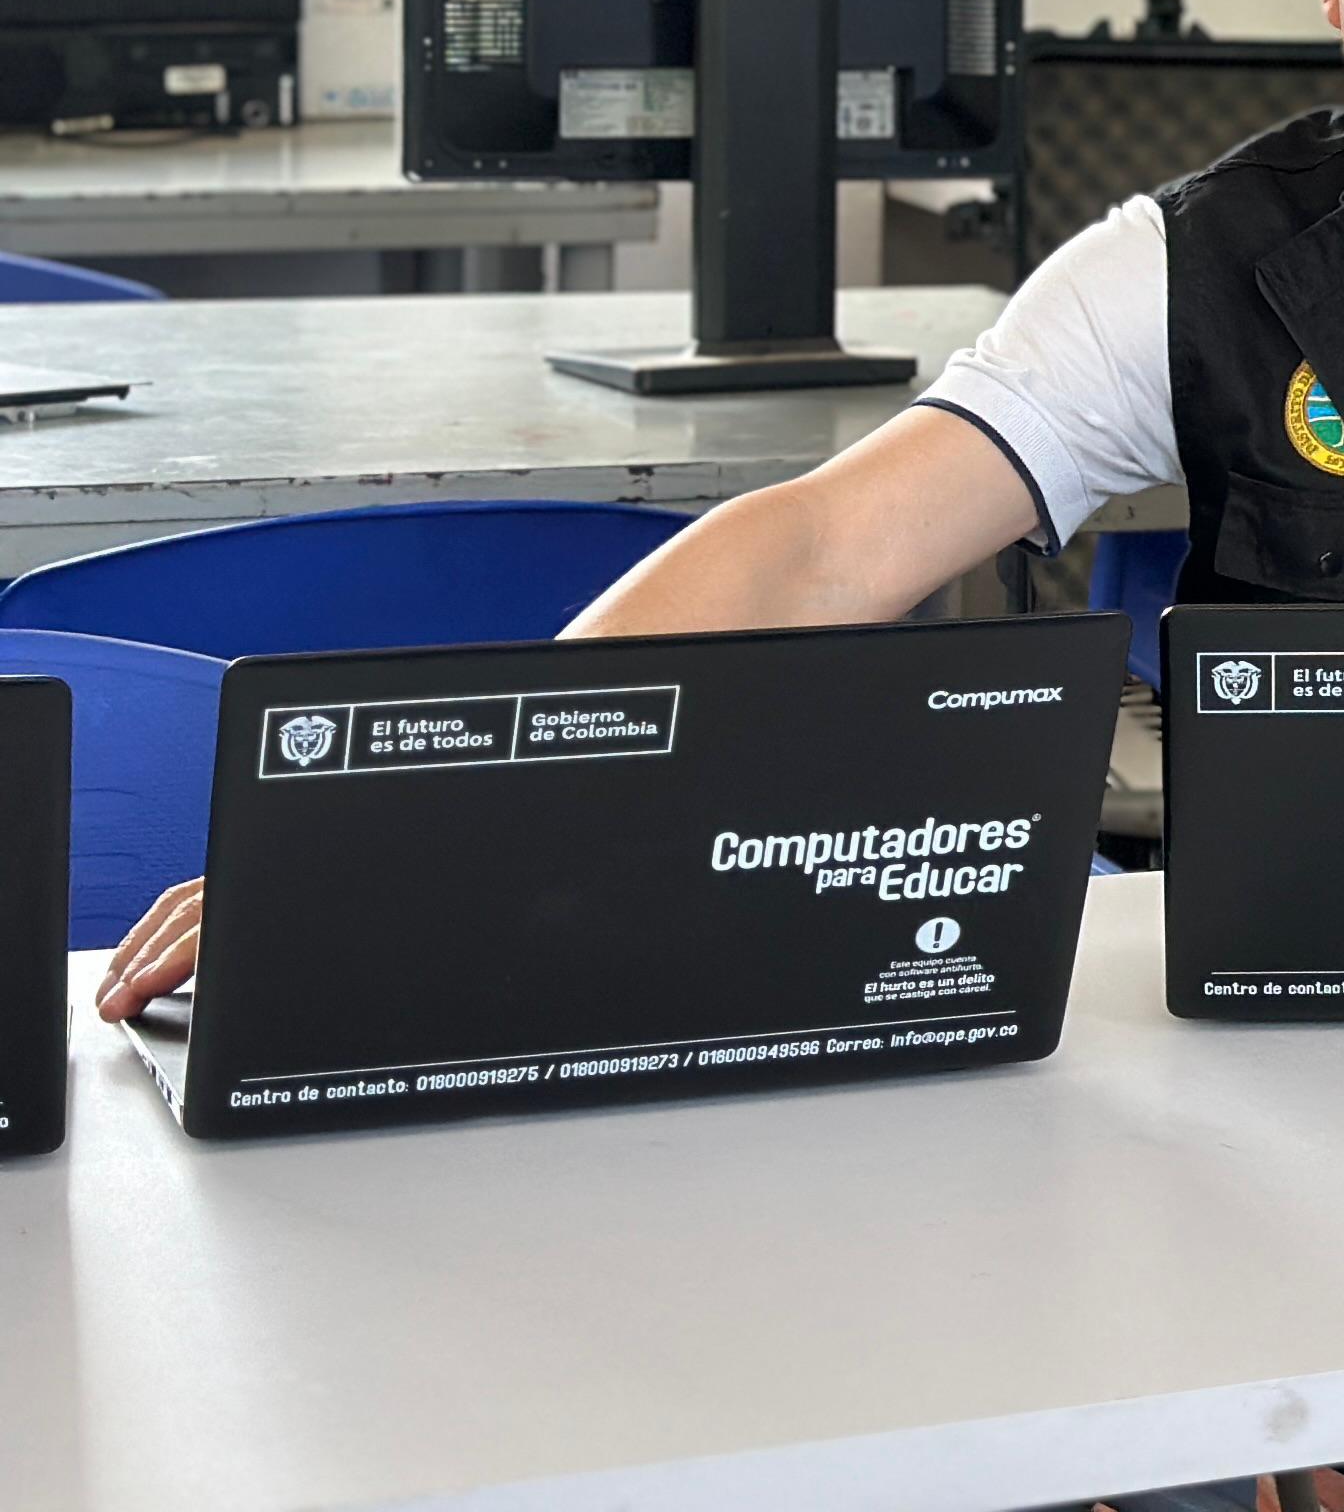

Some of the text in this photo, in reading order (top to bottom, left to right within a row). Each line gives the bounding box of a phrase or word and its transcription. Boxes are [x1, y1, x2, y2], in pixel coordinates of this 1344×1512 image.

[1294, 669, 1309, 682] El
[928, 686, 1063, 711] Compumax
[1293, 687, 1313, 696] es
[1319, 683, 1342, 696] de
[373, 719, 464, 736] El futuro
[532, 709, 624, 726] Gobierno
[530, 721, 658, 741] de Colombia
[371, 732, 492, 753] es de todos
[816, 862, 1023, 900] para Educar
[865, 973, 995, 993] El hurto es un delito
[1205, 982, 1257, 995] Centro
[1264, 982, 1282, 994] de
[231, 1089, 291, 1107] Centro
[298, 1086, 319, 1101] de
[327, 1079, 408, 1098] contacto:
[544, 1064, 555, 1079] /
[683, 1052, 693, 1067] /
[827, 1038, 883, 1053] Correo:
